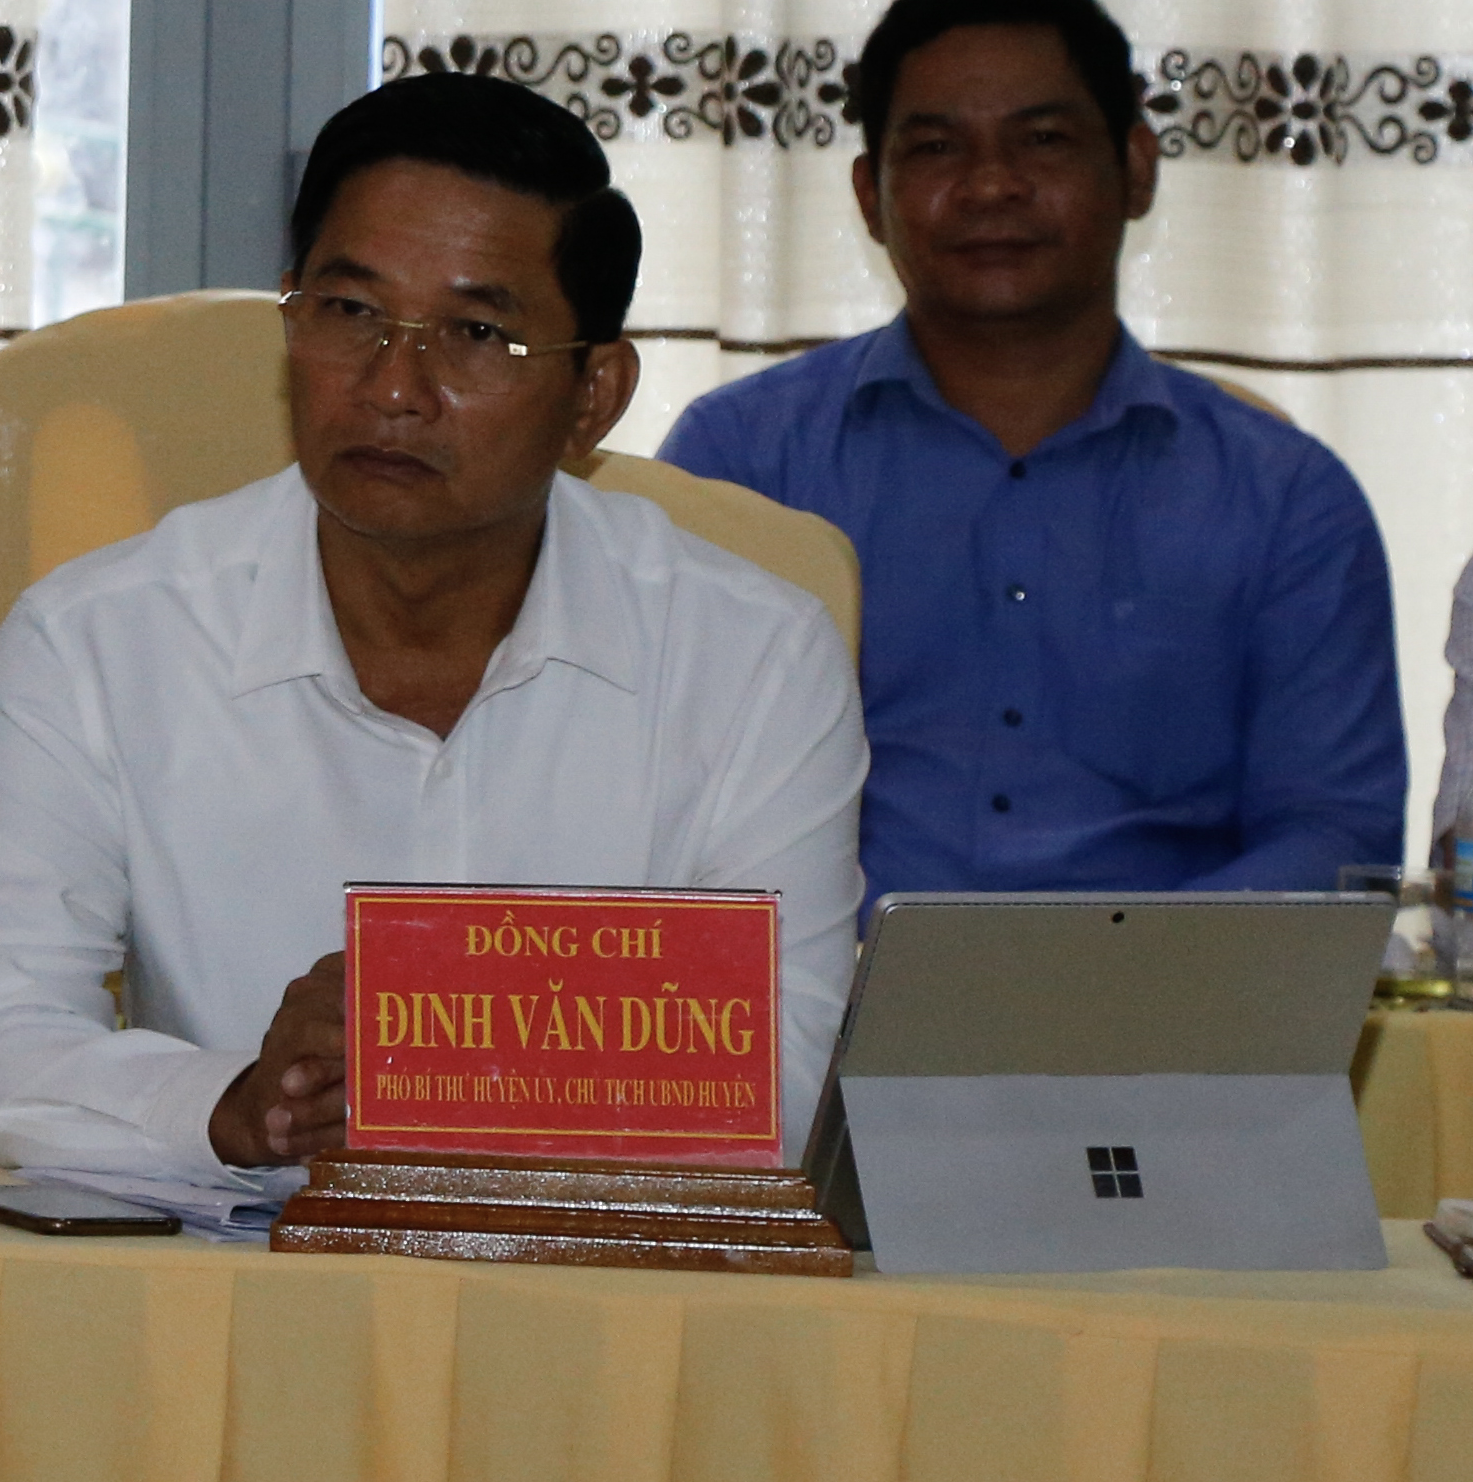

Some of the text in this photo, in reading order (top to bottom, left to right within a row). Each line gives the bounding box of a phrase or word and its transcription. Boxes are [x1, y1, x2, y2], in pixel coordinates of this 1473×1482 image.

[465, 909, 663, 959] ĐỒNG CHÍ
[375, 978, 755, 1056] ĐINH VĂN DŨNG
[414, 1067, 431, 1101] BÍ
